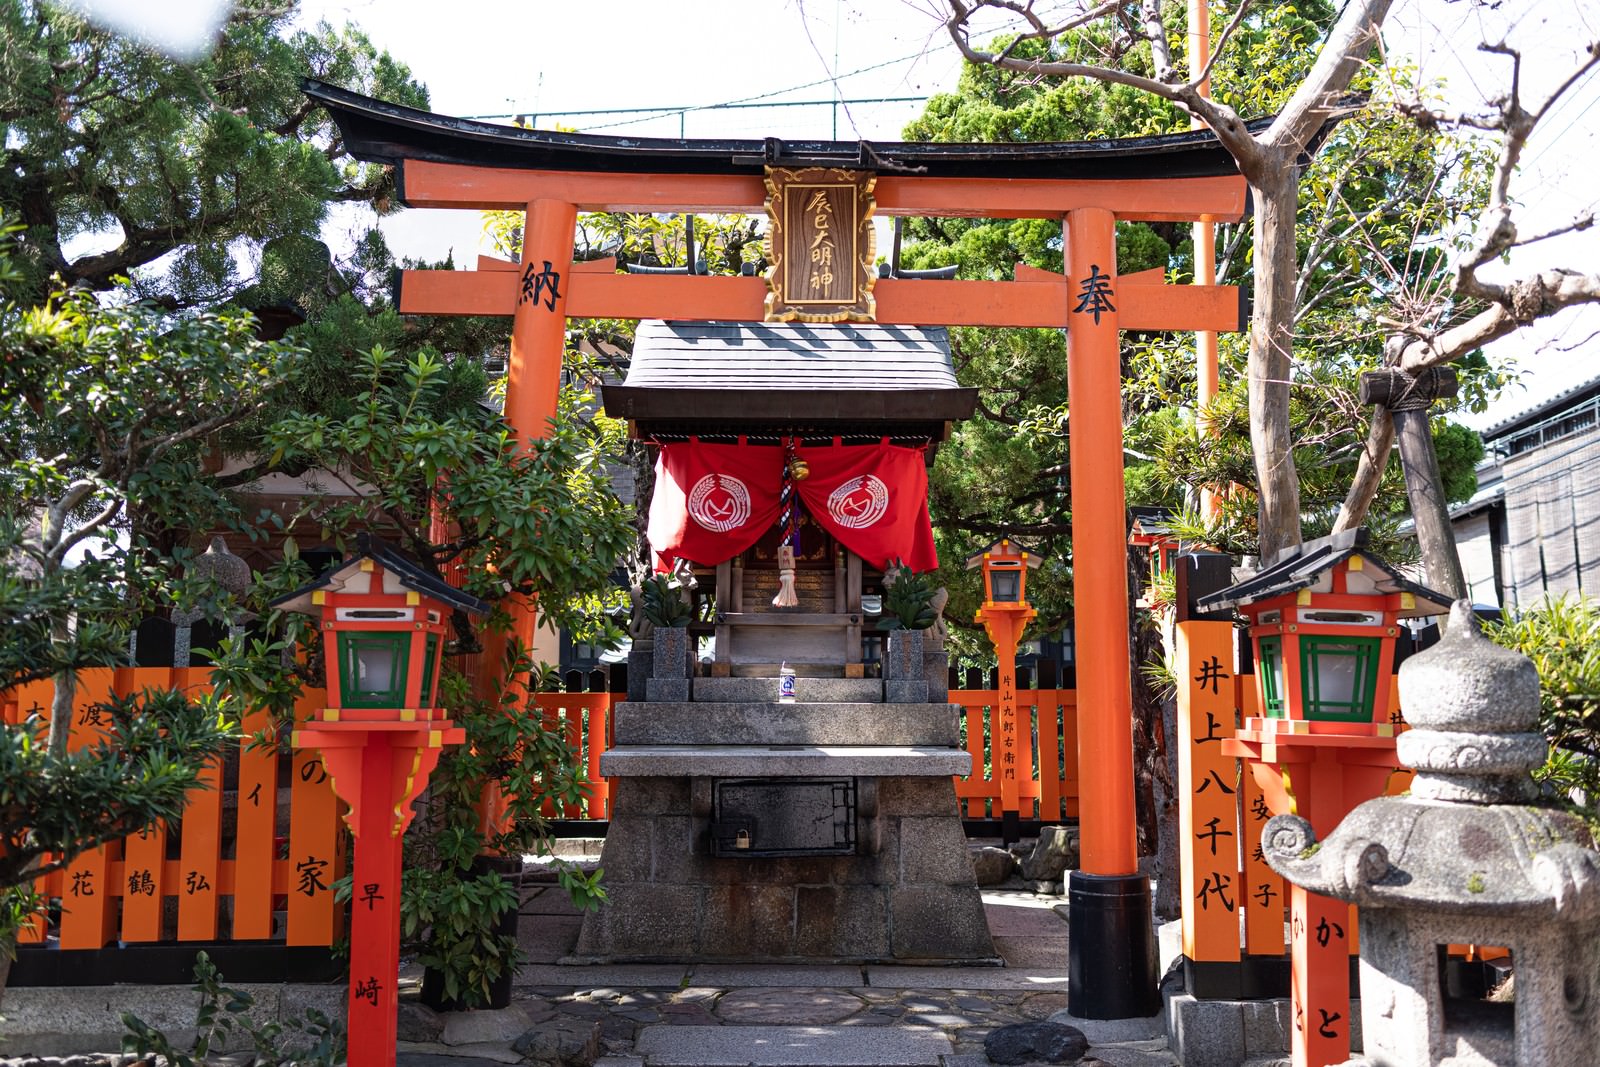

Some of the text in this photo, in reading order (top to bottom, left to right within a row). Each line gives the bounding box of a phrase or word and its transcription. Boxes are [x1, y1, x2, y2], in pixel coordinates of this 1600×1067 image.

[518, 260, 562, 313] 納
[806, 191, 836, 298] 辰巳大明神
[1072, 264, 1117, 327] 奉
[1003, 675, 1015, 780] 片山九郎右衛門
[1194, 655, 1236, 913] 井上八千代
